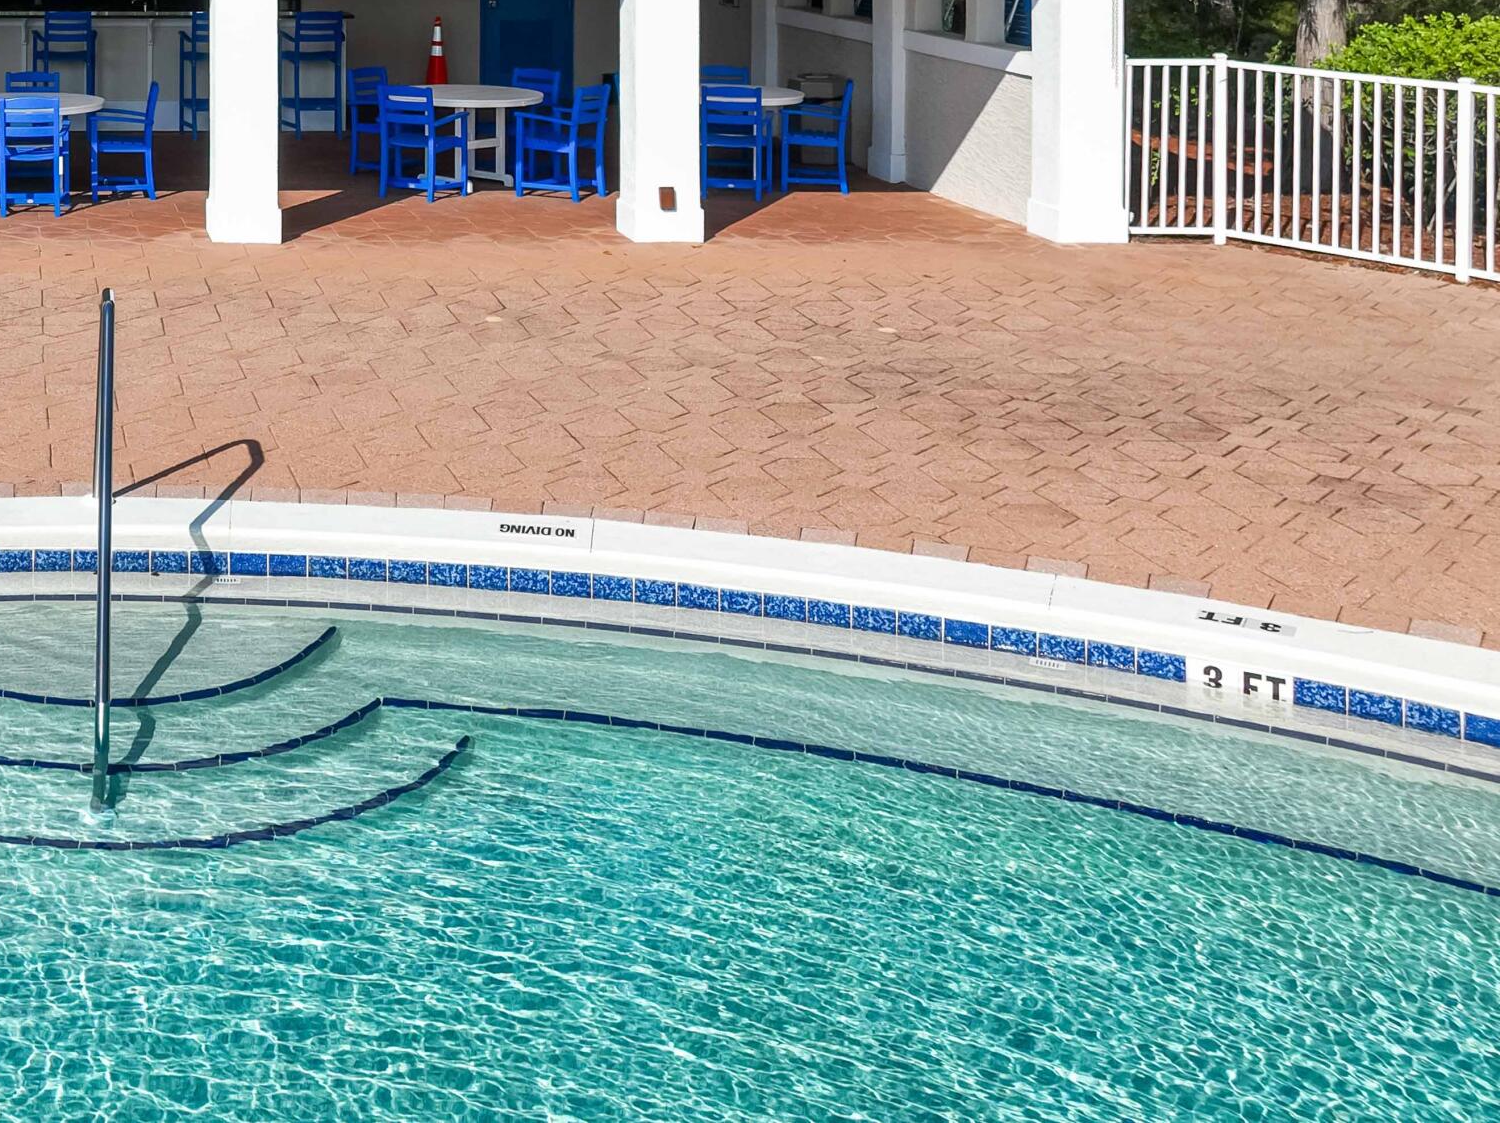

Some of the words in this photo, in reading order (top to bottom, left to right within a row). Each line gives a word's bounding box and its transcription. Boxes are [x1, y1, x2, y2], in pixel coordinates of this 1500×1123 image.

[499, 523, 552, 536] DIVING
[555, 527, 575, 538] NO
[1260, 622, 1282, 633] 3
[1203, 665, 1223, 689] 3
